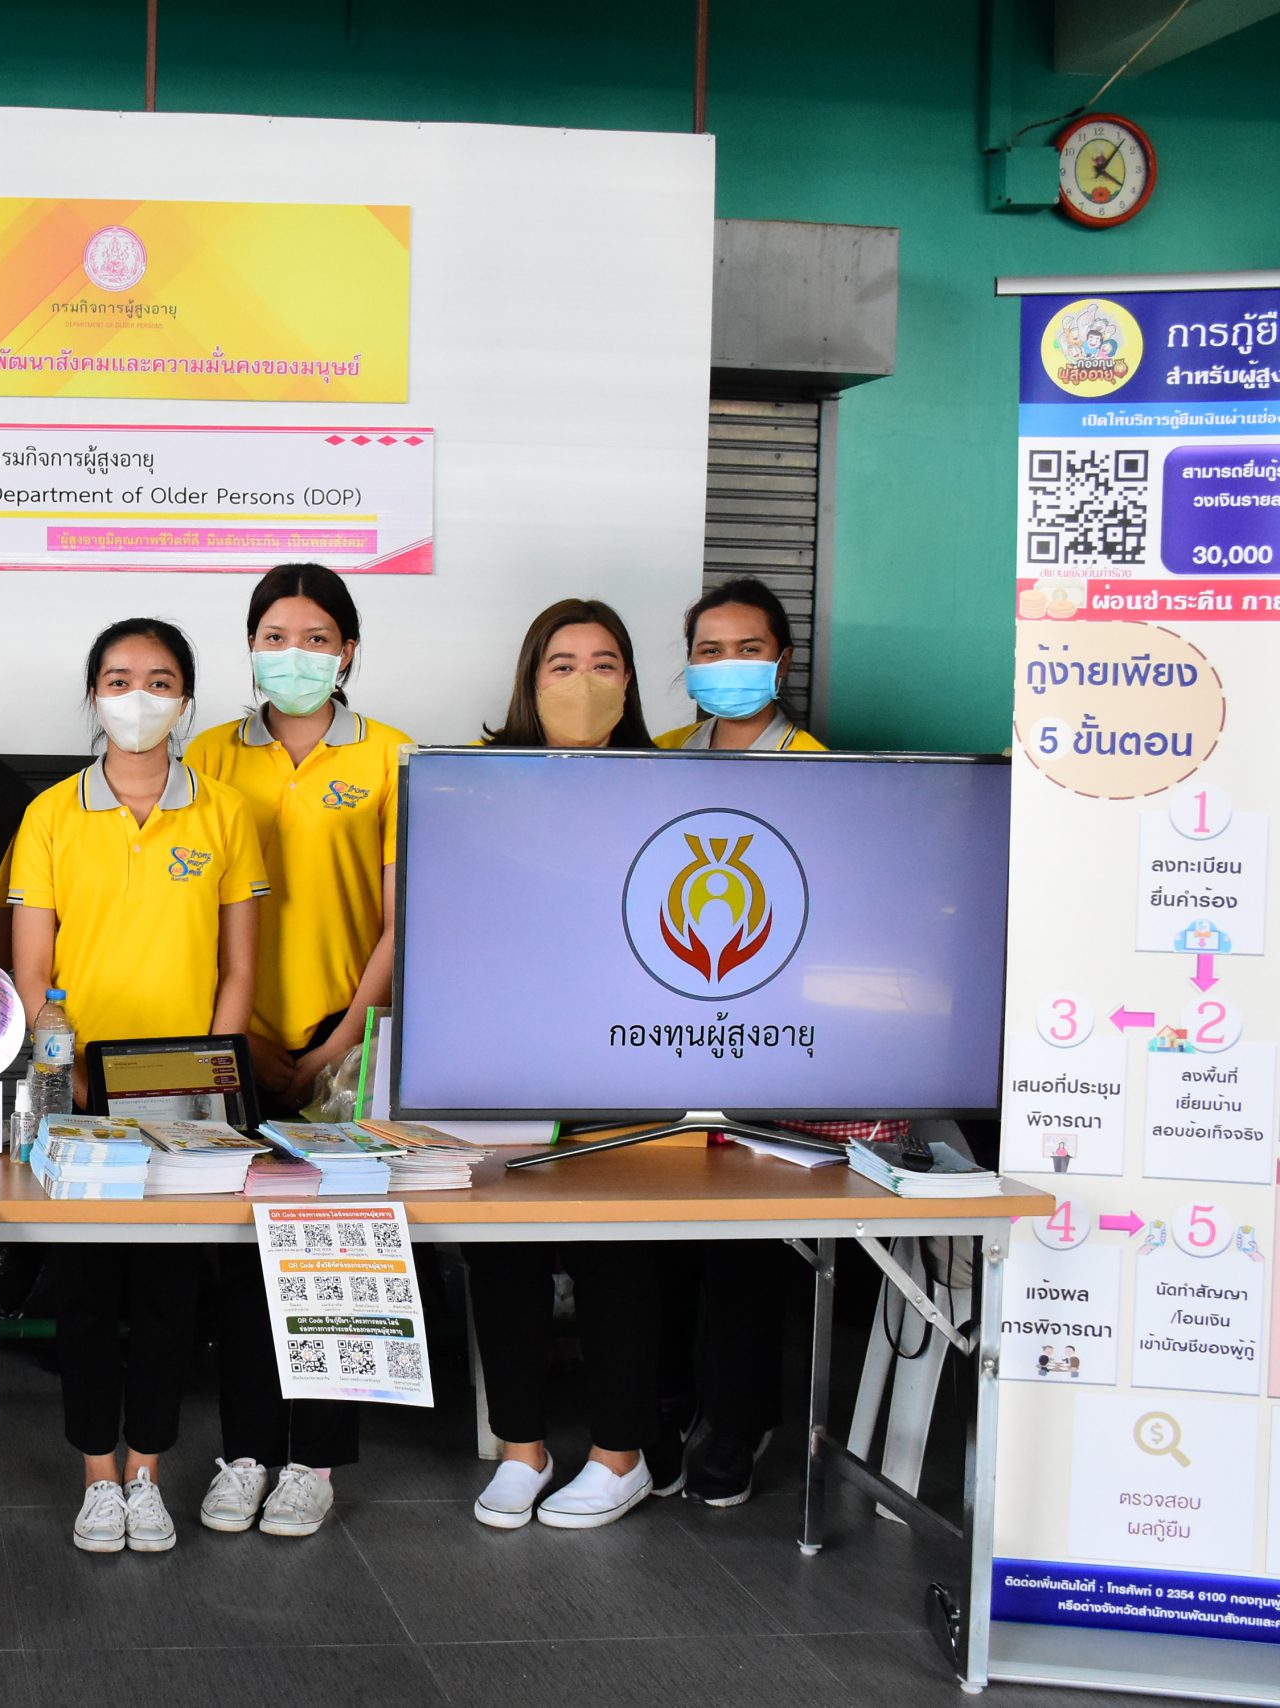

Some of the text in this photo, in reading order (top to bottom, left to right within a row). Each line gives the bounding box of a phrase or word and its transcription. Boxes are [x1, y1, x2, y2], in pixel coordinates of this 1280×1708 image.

[51, 299, 178, 319] กรมกิจการผู้สูงอายุ
[1167, 311, 1278, 355] การกู้ยื
[1057, 363, 1117, 385] ผู้สูงอายุ
[1077, 359, 1114, 369] กองทุน
[1166, 359, 1280, 389] สำหรับผู้สูง
[122, 486, 144, 504] of
[151, 486, 208, 505] Older
[217, 488, 295, 506] Persons
[304, 488, 363, 508] (DOP)
[1192, 545, 1273, 568] 30,000
[1091, 584, 1233, 611] ผ่อนชำระคืน
[1026, 643, 1198, 695] กู้ง่ายเพียง
[1039, 713, 1193, 757] 5 ขั้นตอน
[1193, 791, 1210, 833] 1
[1151, 856, 1242, 875] ลงทะเบียน
[1150, 886, 1238, 909] ยื่นคำร้อง
[1049, 998, 1077, 1041] 3
[1195, 1001, 1226, 1044] 2
[609, 1011, 816, 1060] กองทุนผู้สูงอายุ
[1012, 1072, 1121, 1101] เสนอที่ประชุม
[1181, 1065, 1238, 1085] ลงพื้นที่
[1175, 1094, 1242, 1113] เยี่ยมบ้าน
[1026, 1110, 1102, 1129] พิจารณา
[1152, 1120, 1264, 1142] สอบข้อเท็จจริง
[1045, 1200, 1075, 1242] 4
[1187, 1204, 1217, 1247] 5
[1026, 1278, 1089, 1302] แจ้งผล
[1156, 1282, 1248, 1301] นัดทำสัญญา
[1001, 1318, 1112, 1338] การพิจารณา
[1170, 1310, 1231, 1328] /โอนเงิน
[1139, 1333, 1256, 1361] เข้าบัญชีของผู้กู้
[1119, 1491, 1202, 1510] ตรวจสอบ
[1127, 1519, 1191, 1542] ผลกู้ยืม
[1004, 1574, 1096, 1593] ติดต่อเพิ่มเติมได้ที่
[1107, 1581, 1153, 1597] โทรศัพท์
[1155, 1588, 1163, 1597] 0
[1166, 1588, 1195, 1600] 2354
[1198, 1591, 1227, 1603] 6100
